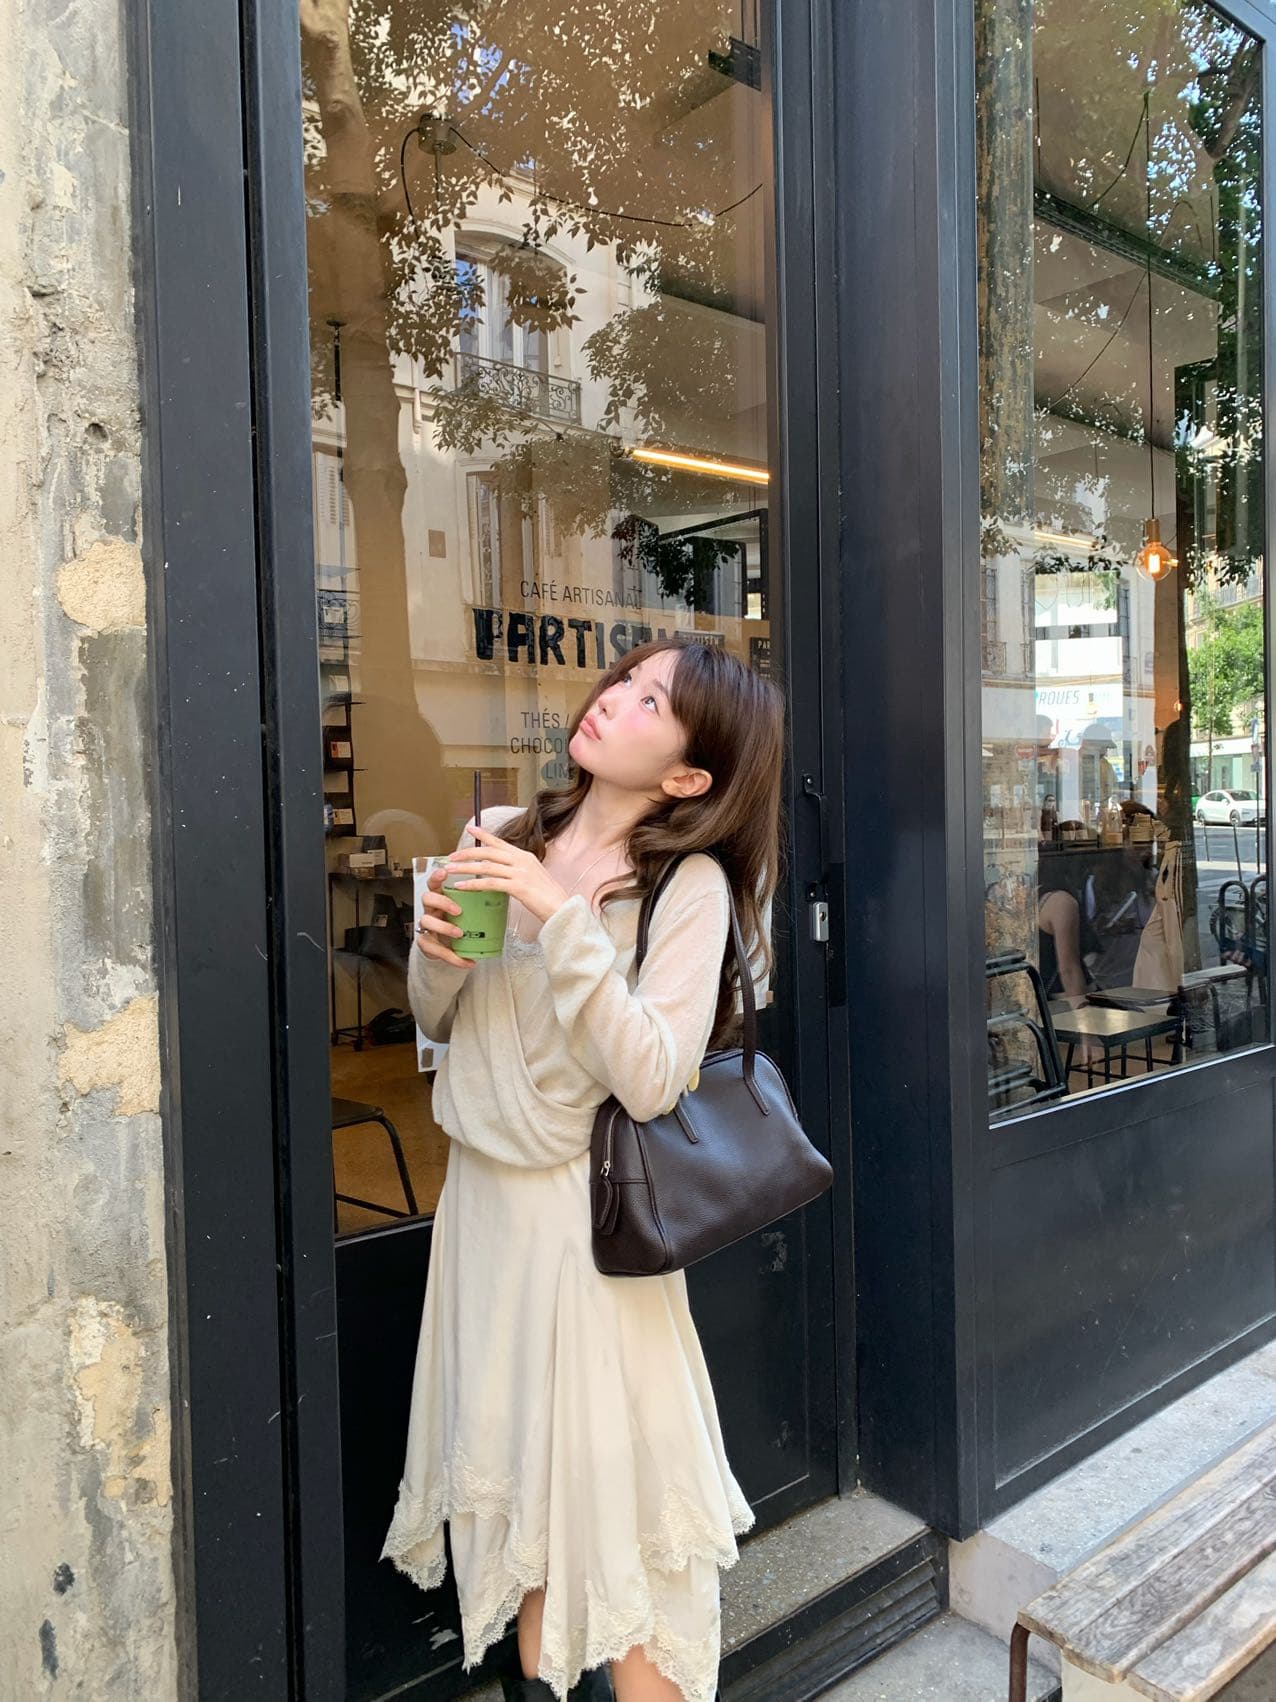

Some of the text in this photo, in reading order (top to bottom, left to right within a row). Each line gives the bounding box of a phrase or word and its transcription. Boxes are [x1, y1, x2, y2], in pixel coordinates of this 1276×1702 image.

[520, 580, 642, 610] CAFÉ ARTISANAL
[472, 608, 681, 670] PARTIS
[520, 707, 561, 729] THÉS
